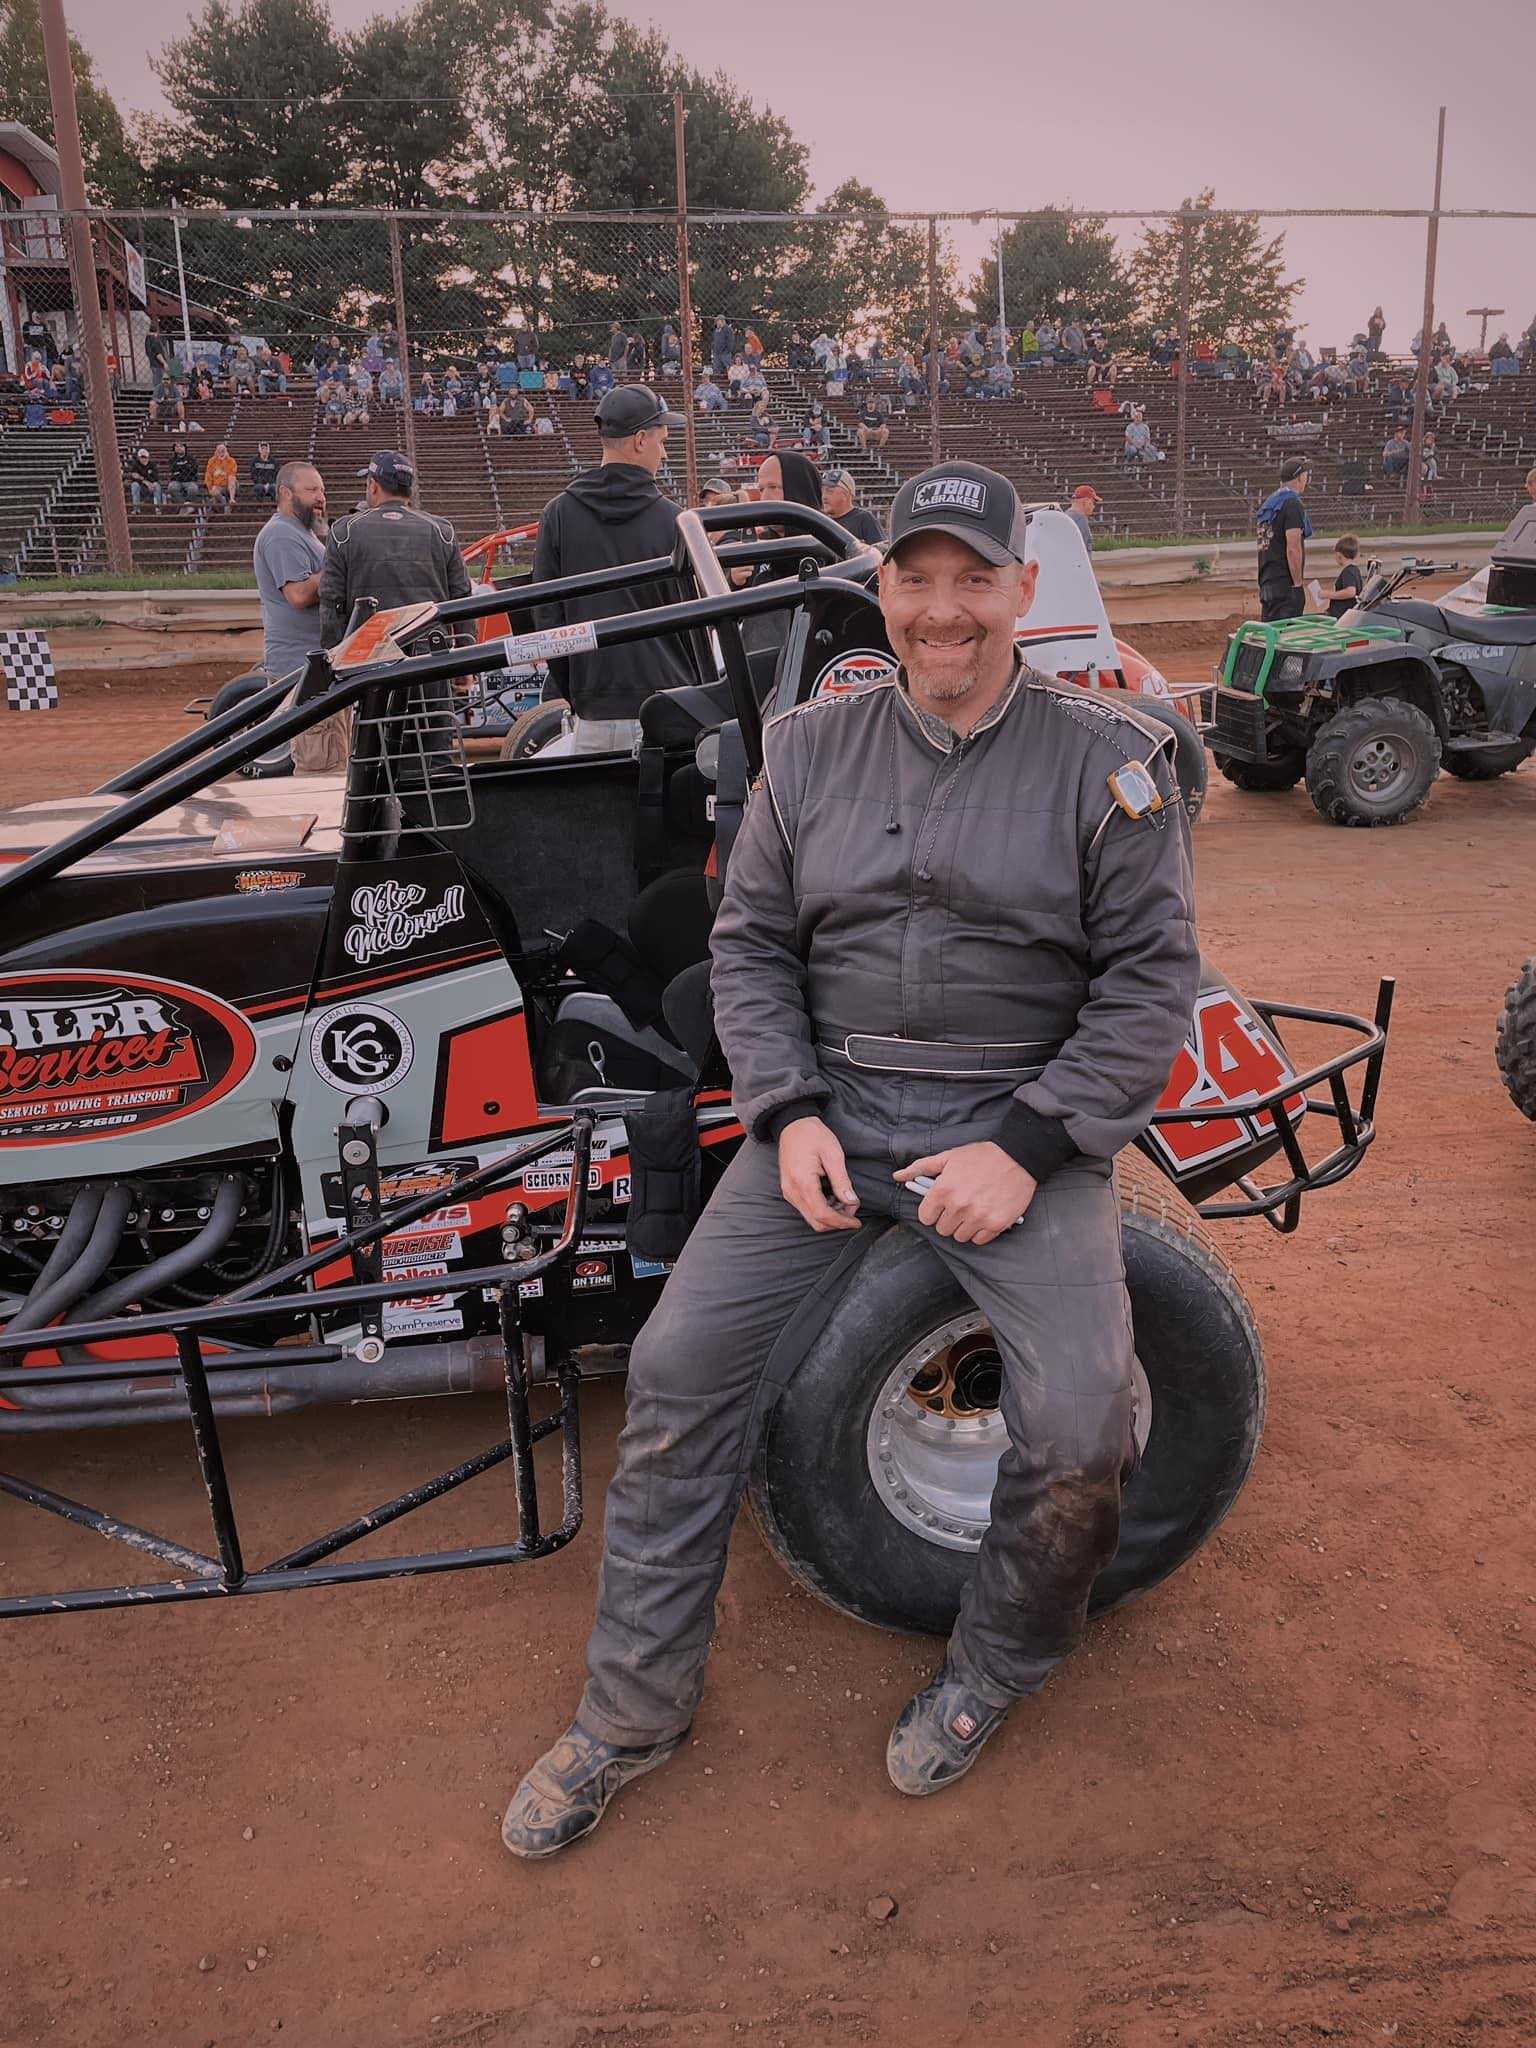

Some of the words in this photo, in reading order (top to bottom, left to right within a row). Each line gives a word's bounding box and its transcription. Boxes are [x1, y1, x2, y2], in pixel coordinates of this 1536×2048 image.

[931, 494, 980, 509] BRAKES
[550, 626, 587, 640] 2023
[352, 881, 425, 927] Kelsee
[345, 887, 464, 962] McConnell
[379, 1053, 395, 1061] LLC
[0, 1103, 48, 1119] SERVICE
[55, 1098, 102, 1113] TOWING
[107, 1088, 174, 1107] TRANSPORT
[527, 1169, 597, 1188] SCHOEND
[382, 1232, 456, 1257] RECISE
[572, 1278, 587, 1287] ON
[588, 1275, 613, 1284] TIME
[383, 1317, 461, 1332] DrumPreserve
